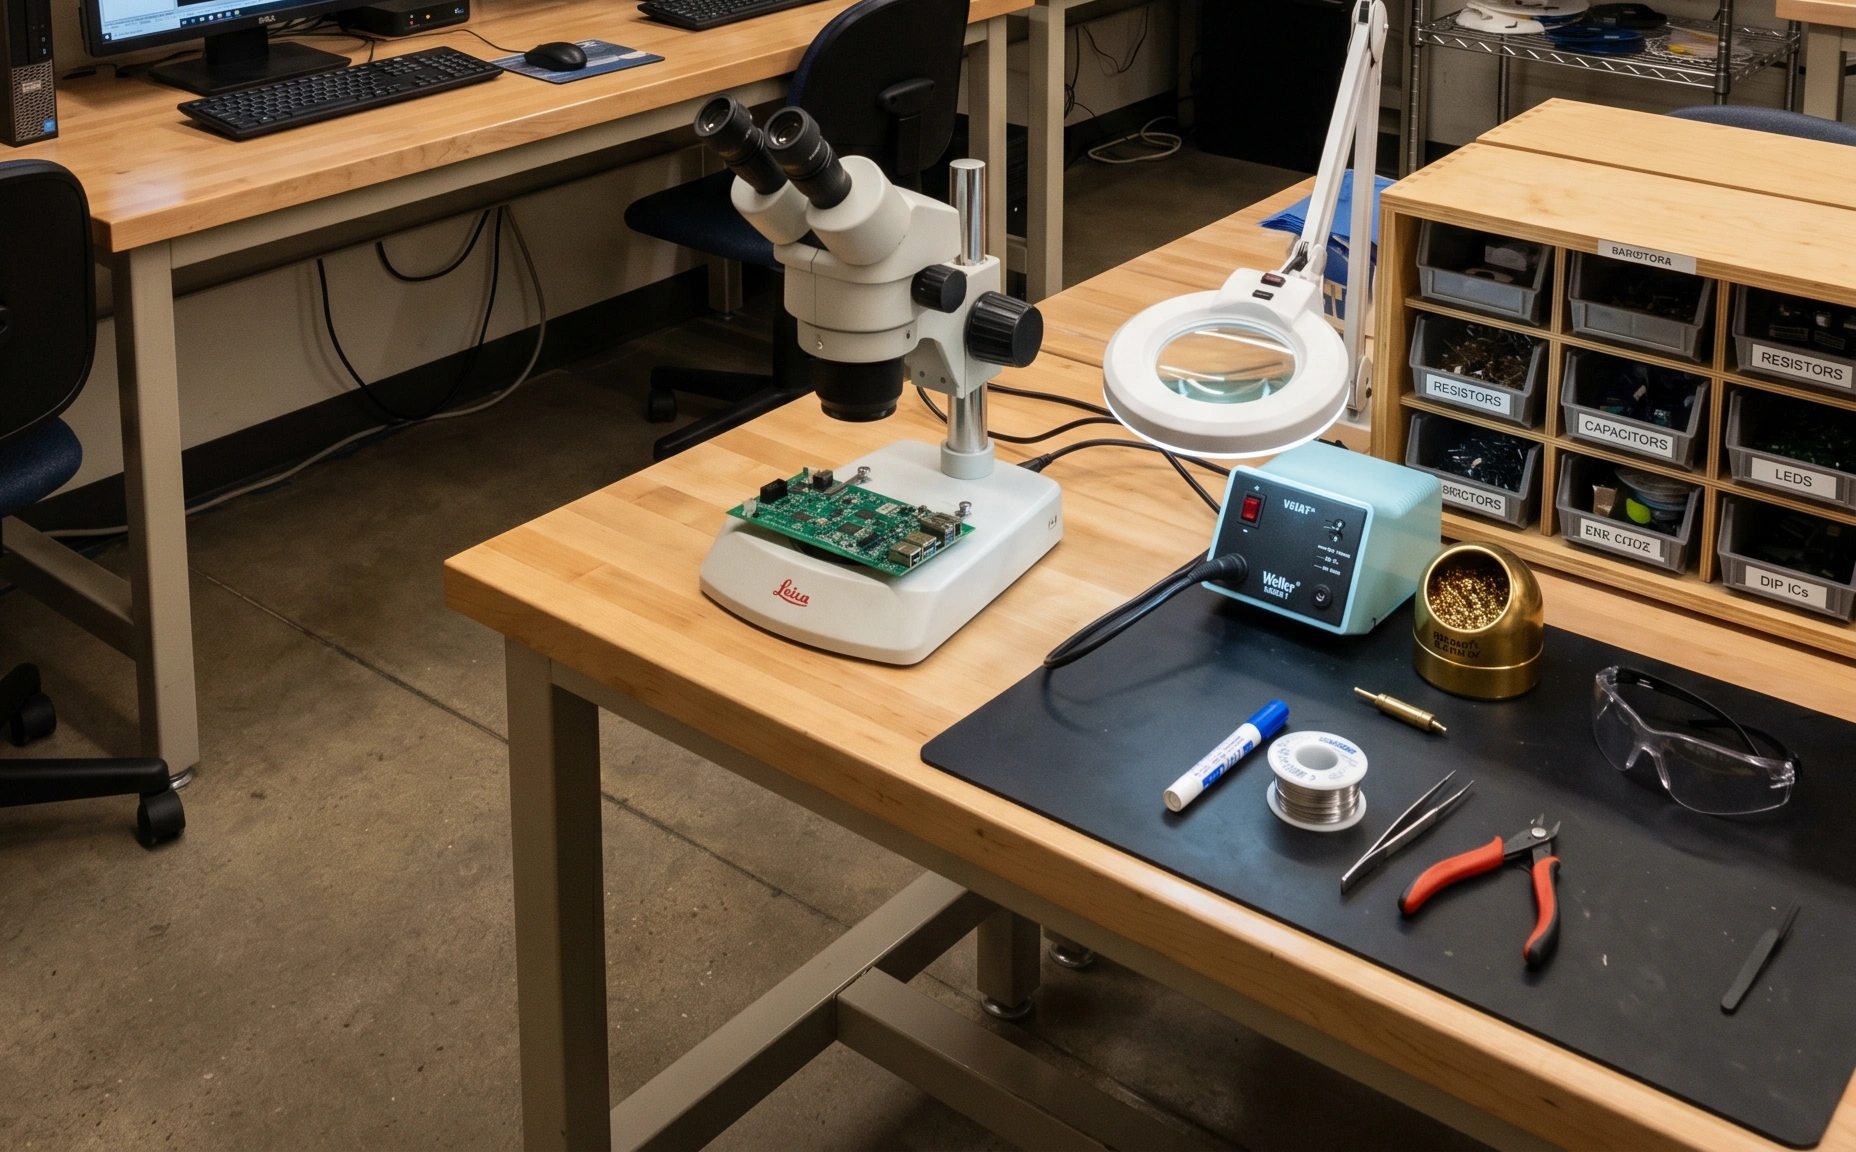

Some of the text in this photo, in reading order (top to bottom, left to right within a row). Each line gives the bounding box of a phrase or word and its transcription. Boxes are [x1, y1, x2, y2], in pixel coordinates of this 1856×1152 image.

[1761, 352, 1843, 380] RESISTORS
[1433, 381, 1502, 407] RESISTORS
[1585, 420, 1668, 450] CAPACITORS
[1775, 468, 1813, 487] LEDS
[1263, 570, 1296, 593] Weller
[1760, 575, 1809, 598] DIP ICs
